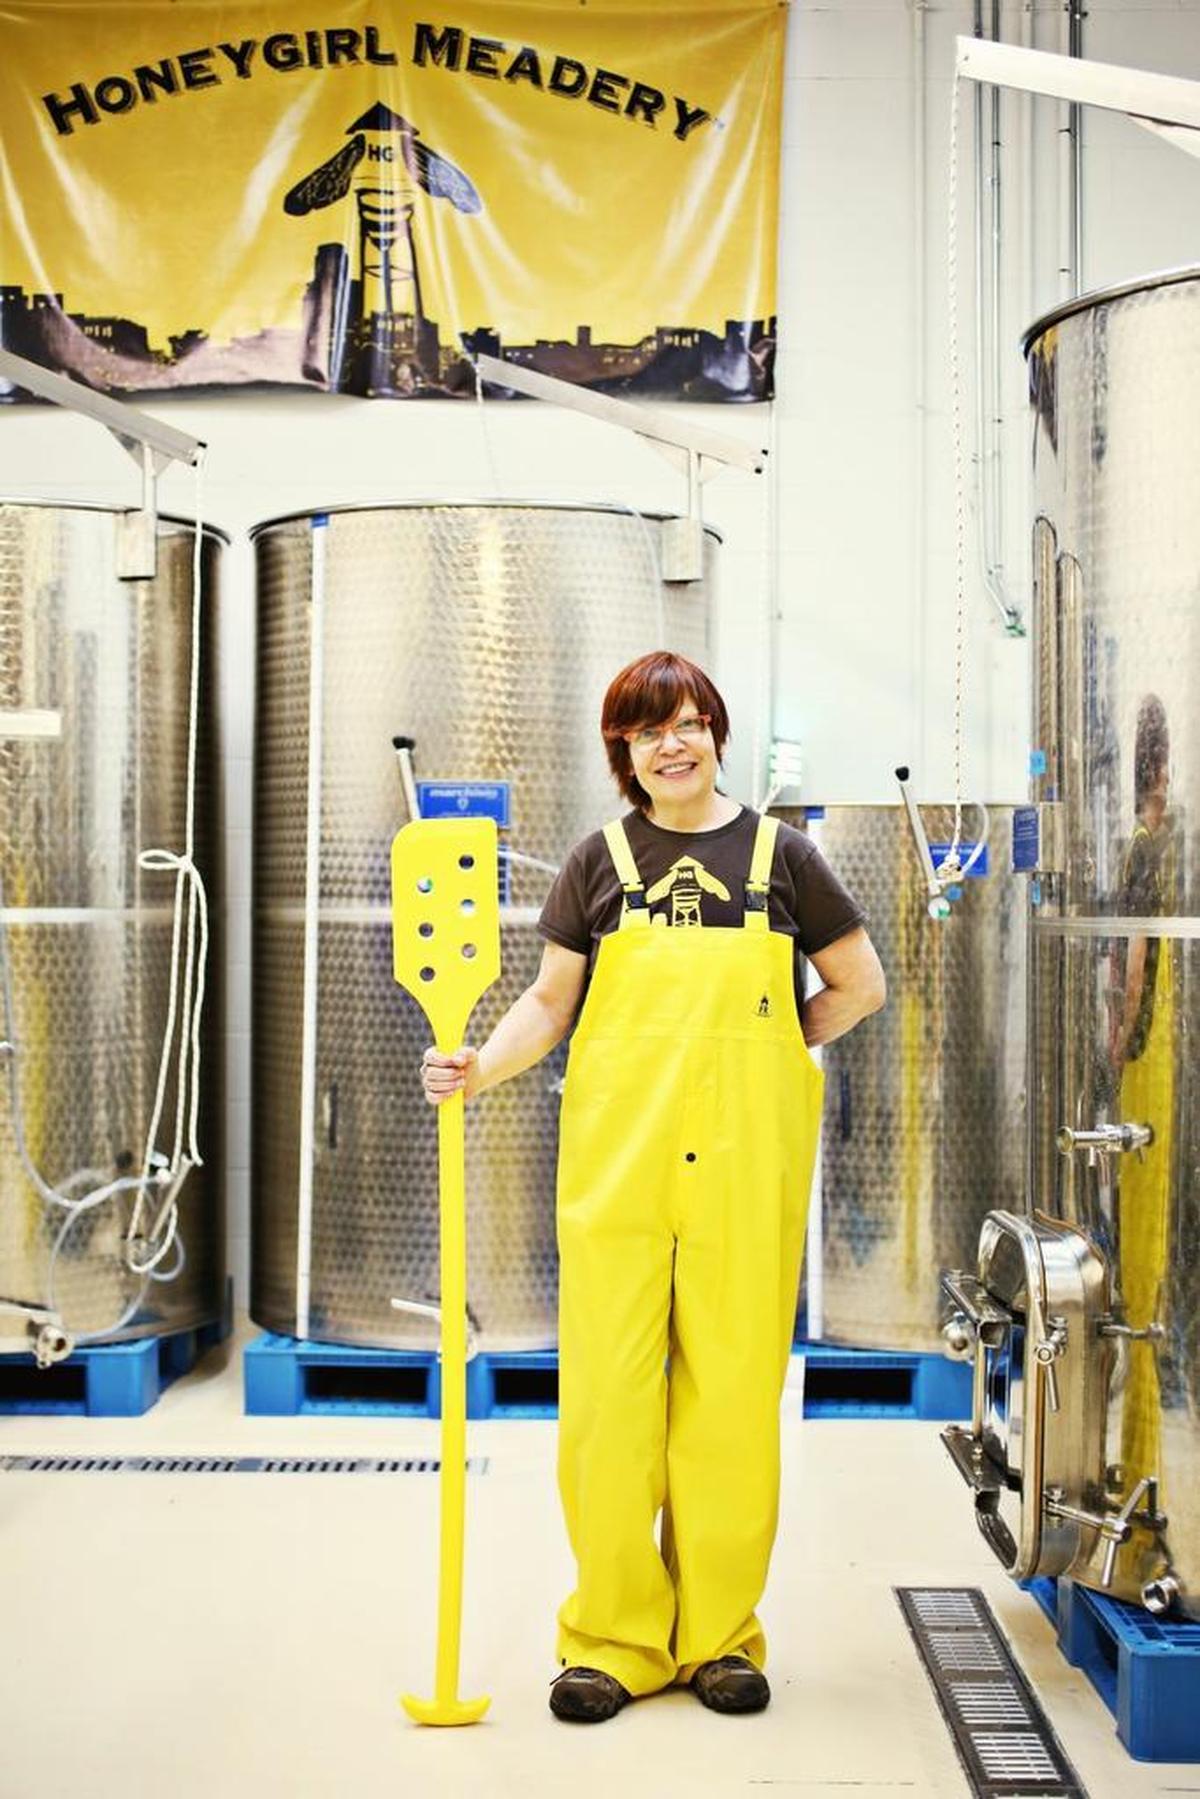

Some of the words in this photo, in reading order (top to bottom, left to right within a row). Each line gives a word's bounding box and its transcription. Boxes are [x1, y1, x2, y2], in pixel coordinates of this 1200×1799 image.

[43, 25, 396, 135] HONEYGIRL
[413, 23, 710, 141] MEADERY
[368, 144, 394, 162] HG
